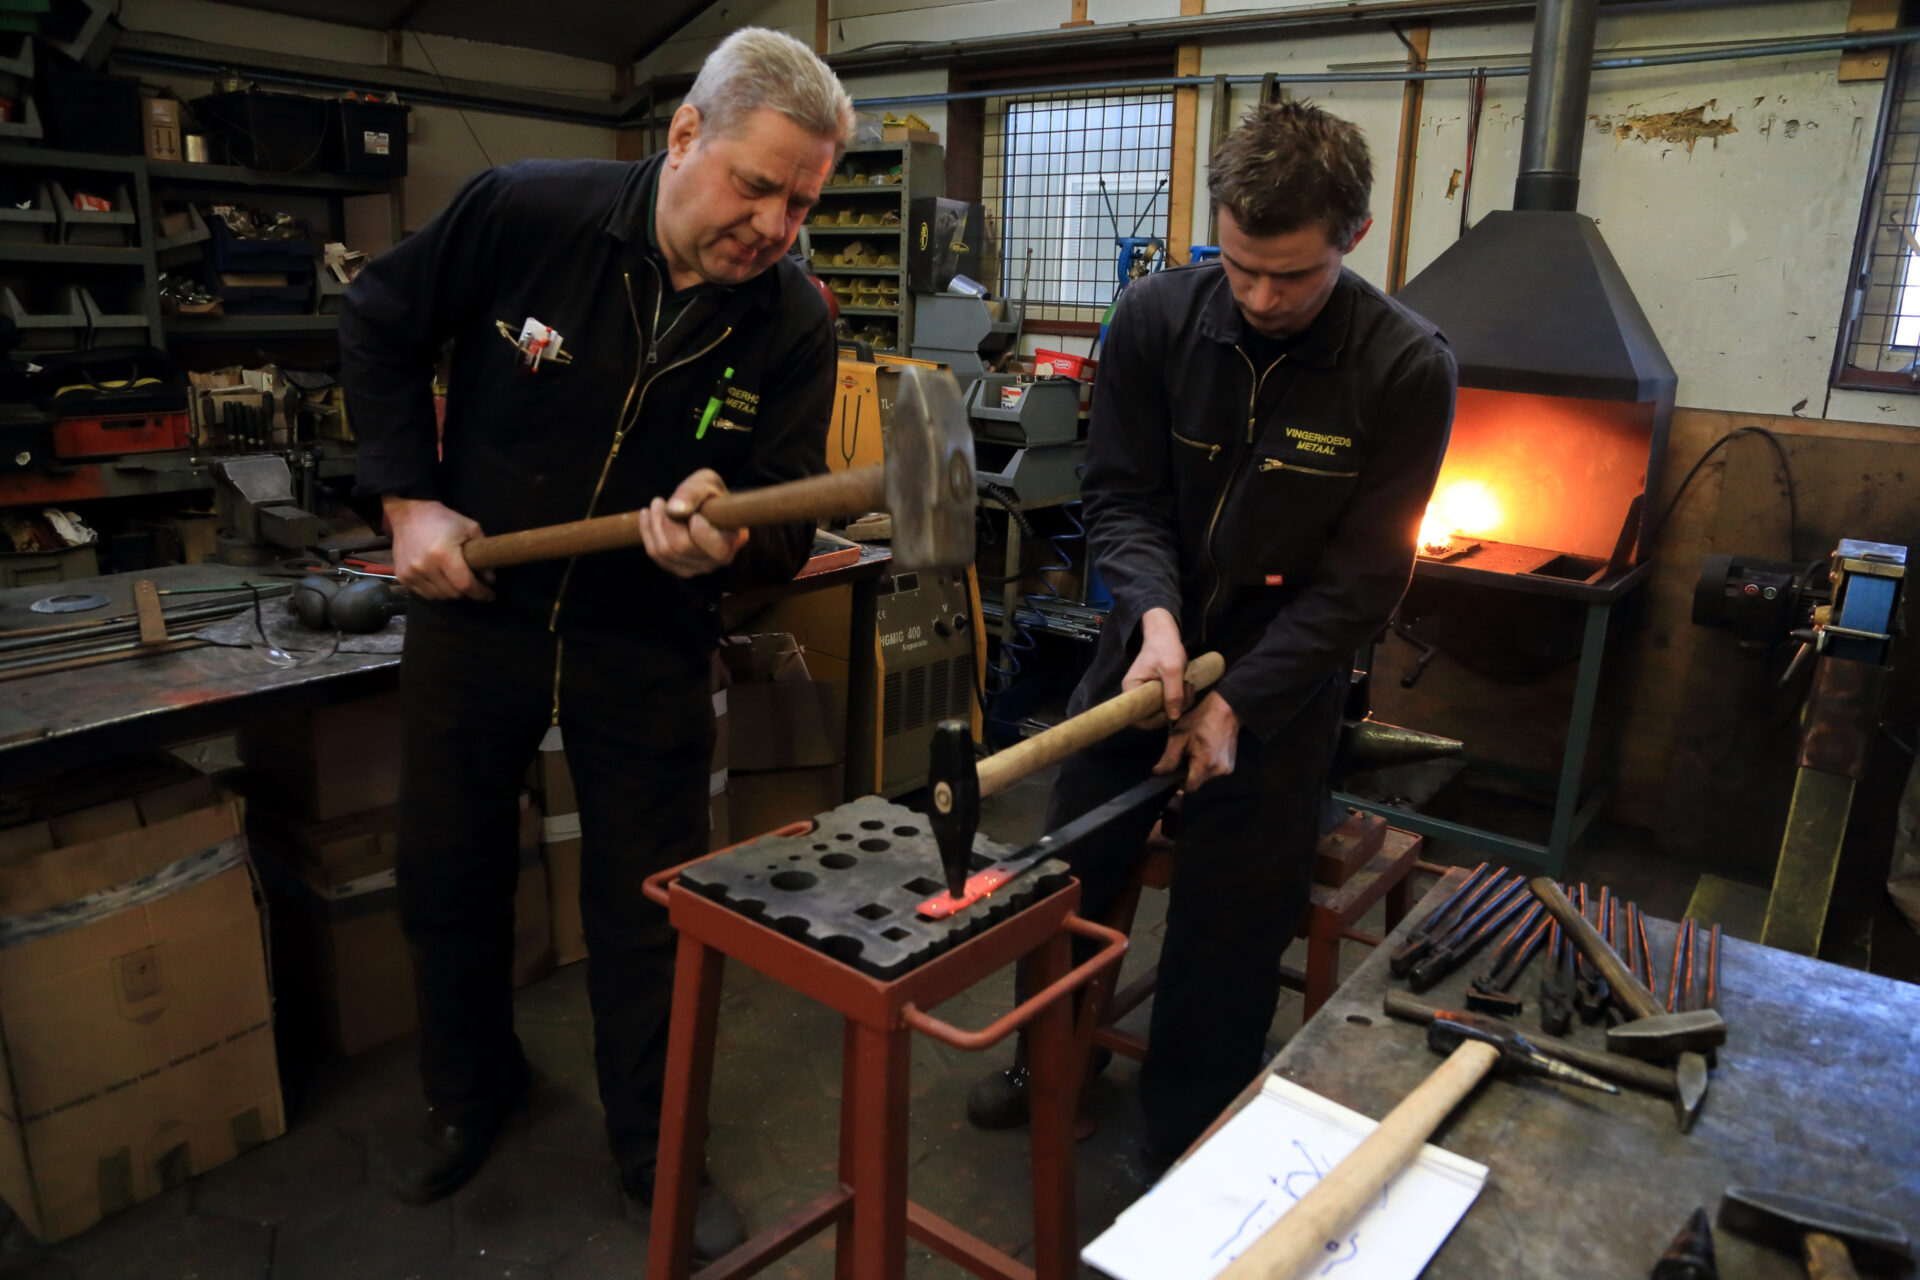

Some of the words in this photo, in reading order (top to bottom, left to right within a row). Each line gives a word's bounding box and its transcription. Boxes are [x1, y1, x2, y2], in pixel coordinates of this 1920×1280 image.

[1286, 427, 1352, 448] VINGERHOEDS
[1296, 440, 1336, 456] METAAL
[907, 626, 921, 640] 400
